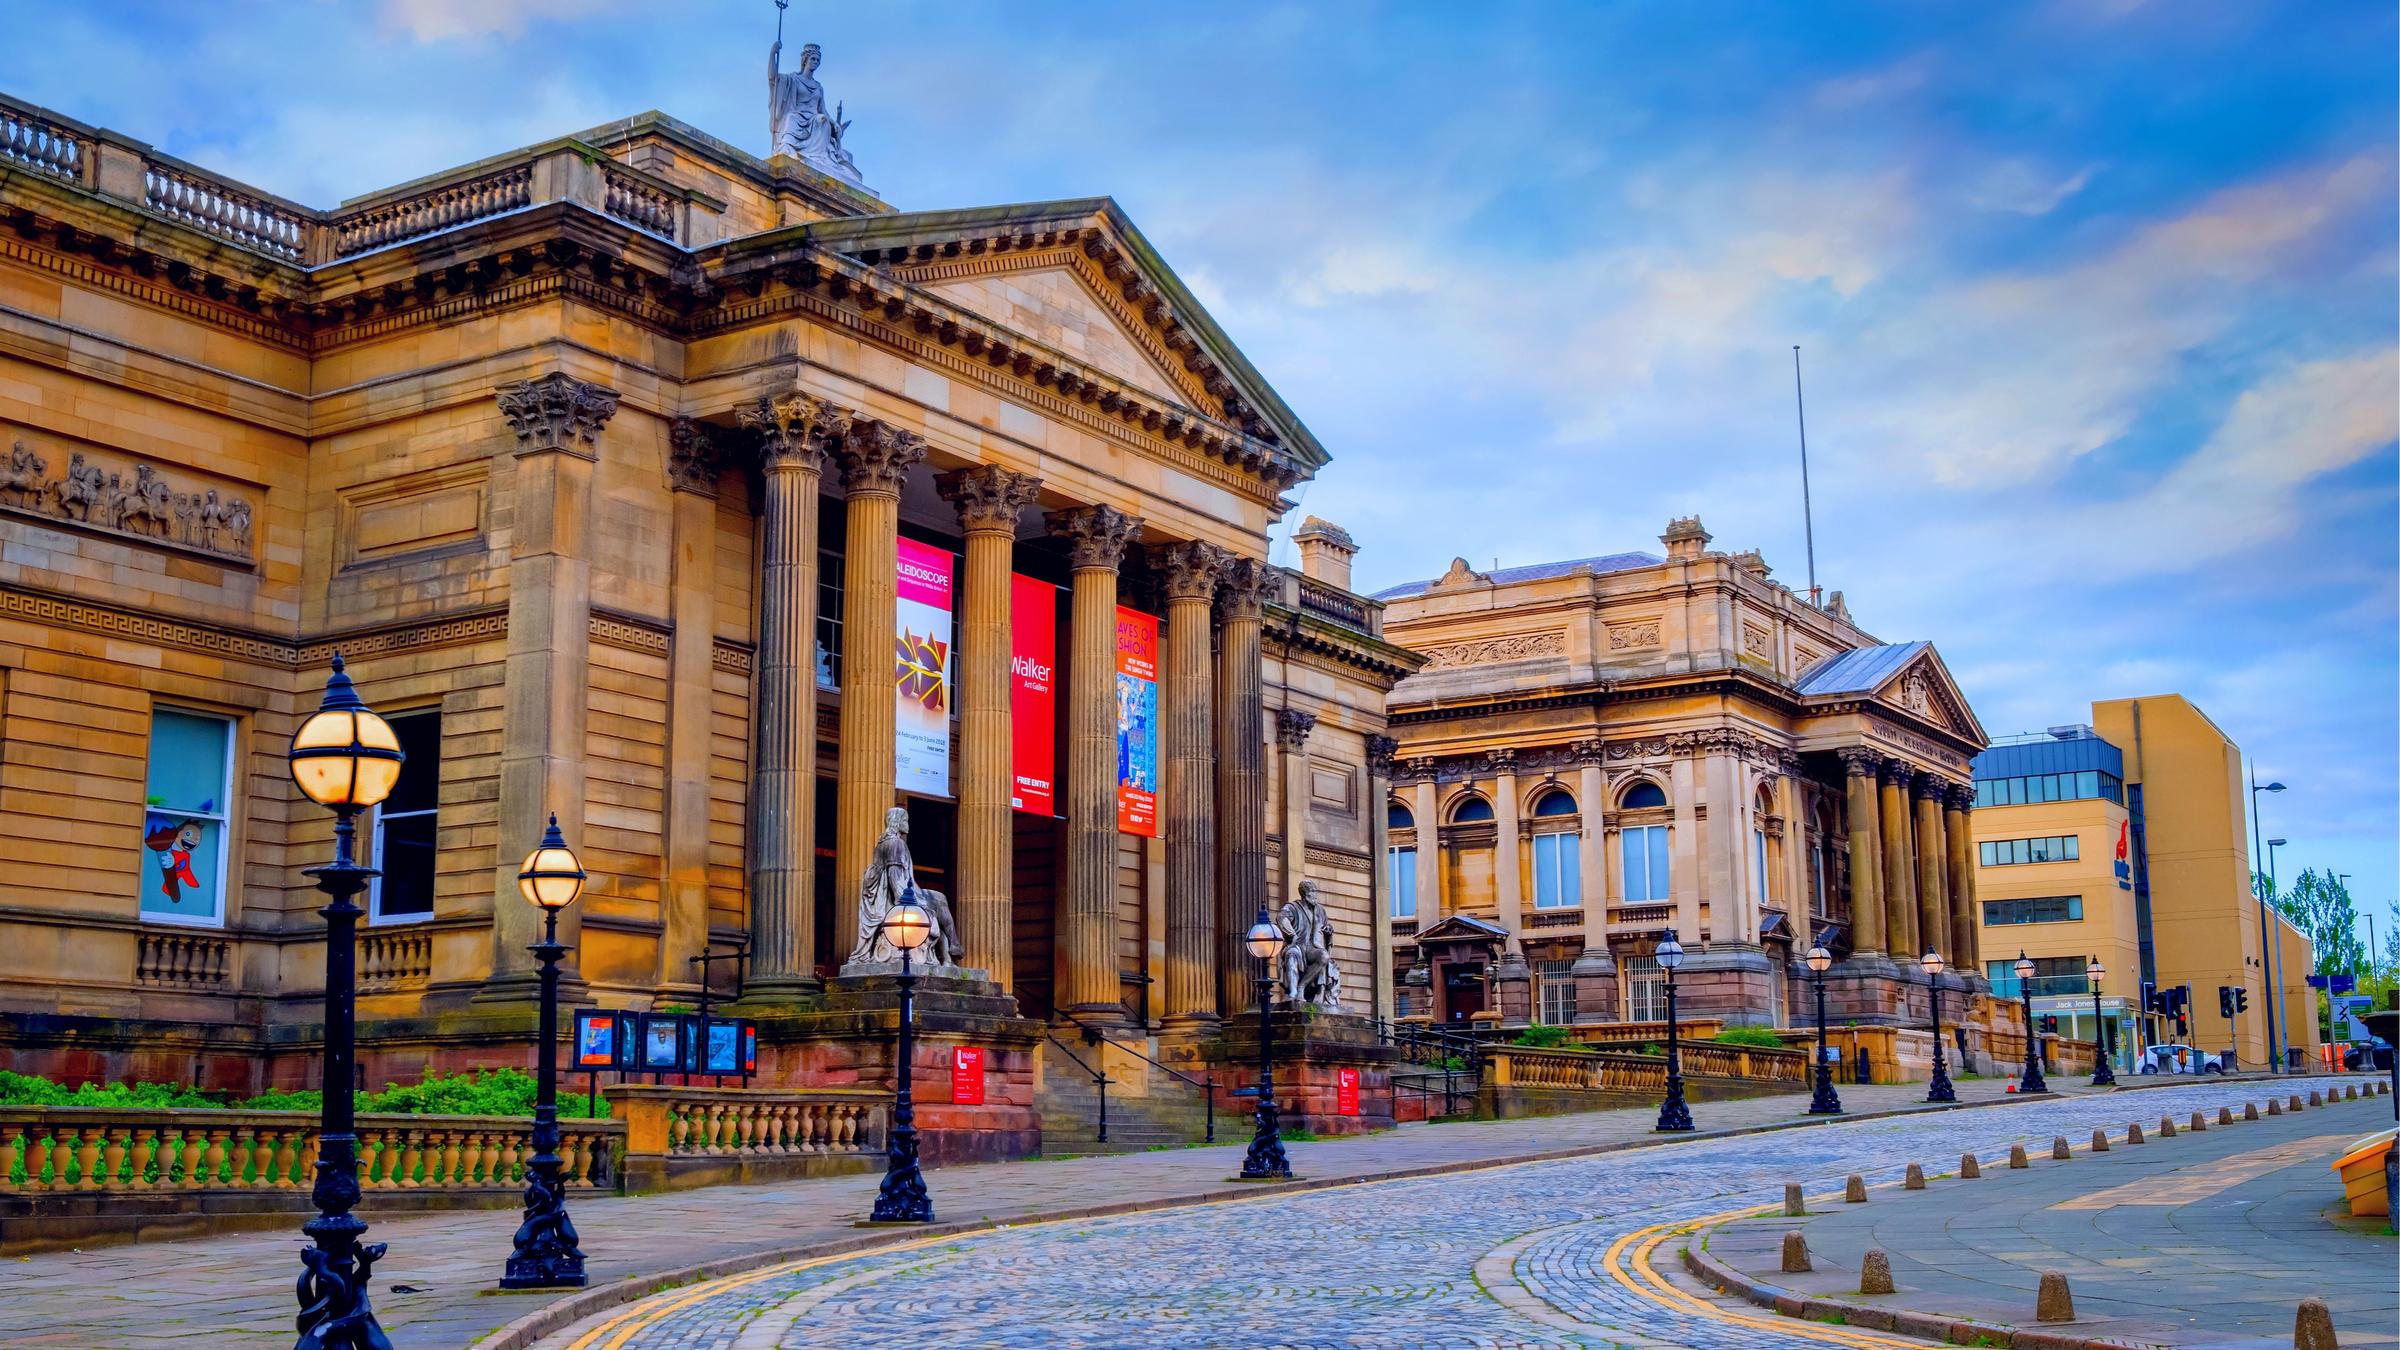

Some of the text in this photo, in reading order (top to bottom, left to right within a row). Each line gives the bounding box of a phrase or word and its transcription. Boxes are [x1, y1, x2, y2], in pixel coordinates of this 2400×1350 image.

[897, 562, 949, 587] ALEIDOSCOPE
[1118, 621, 1138, 638] AVES
[1118, 637, 1147, 657] SHION
[1011, 655, 1051, 682] Walker
[1024, 680, 1048, 694] Art Gallery
[897, 753, 911, 764] alker
[1017, 775, 1050, 789] FREE ENTRY
[2055, 999, 2120, 1009] Jack Jones ouse
